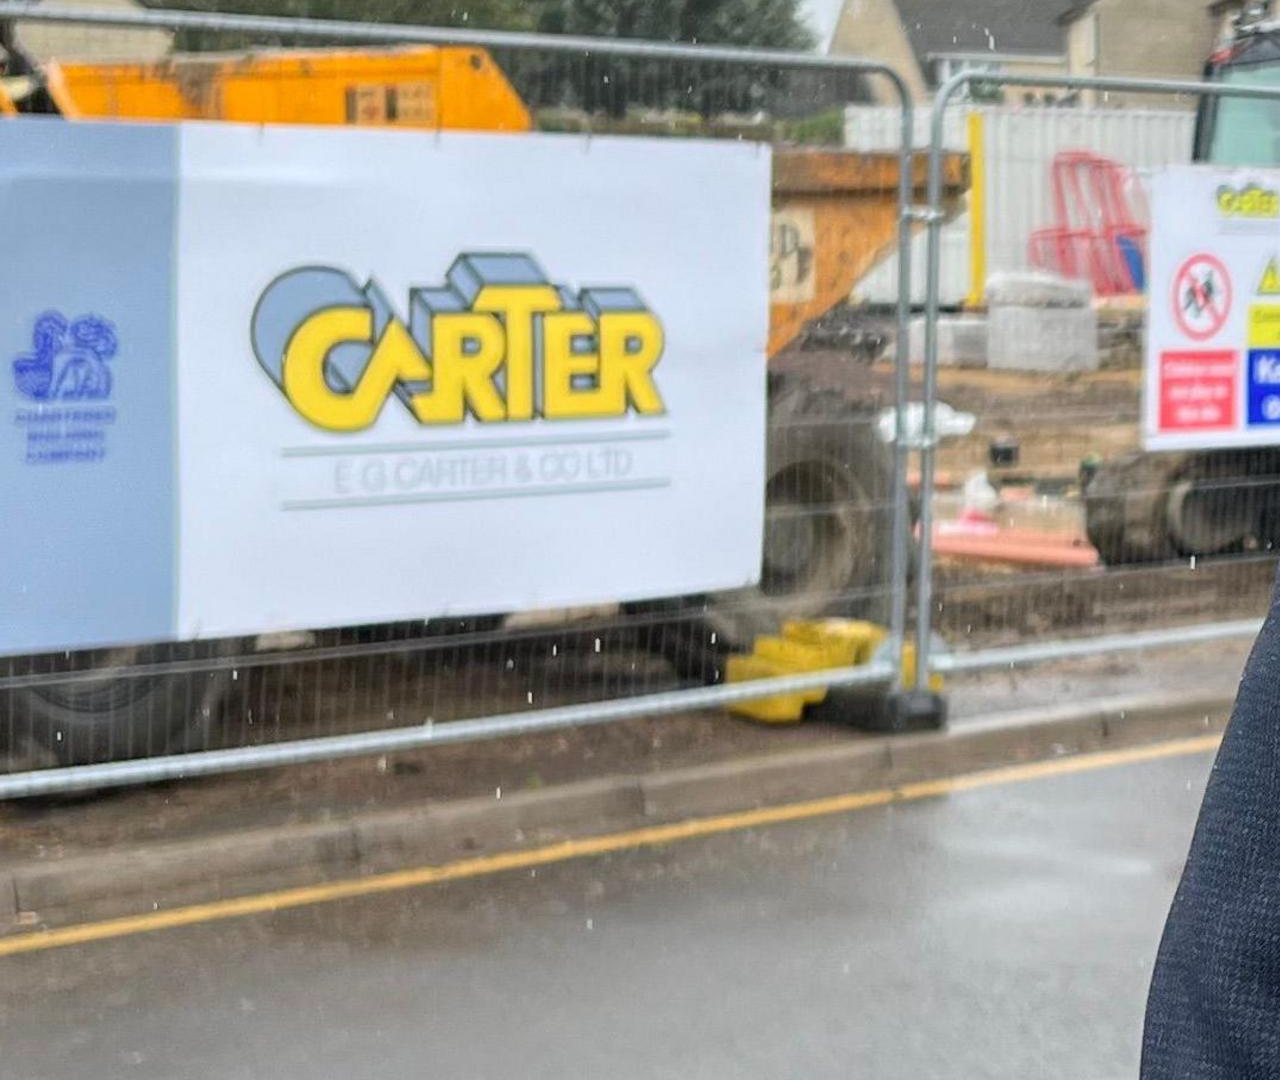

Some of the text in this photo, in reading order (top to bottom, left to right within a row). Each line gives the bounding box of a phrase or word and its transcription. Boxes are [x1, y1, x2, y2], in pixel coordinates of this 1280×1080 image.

[280, 284, 667, 434] CARTER
[334, 446, 633, 493] E G CARTER & CO LTD
